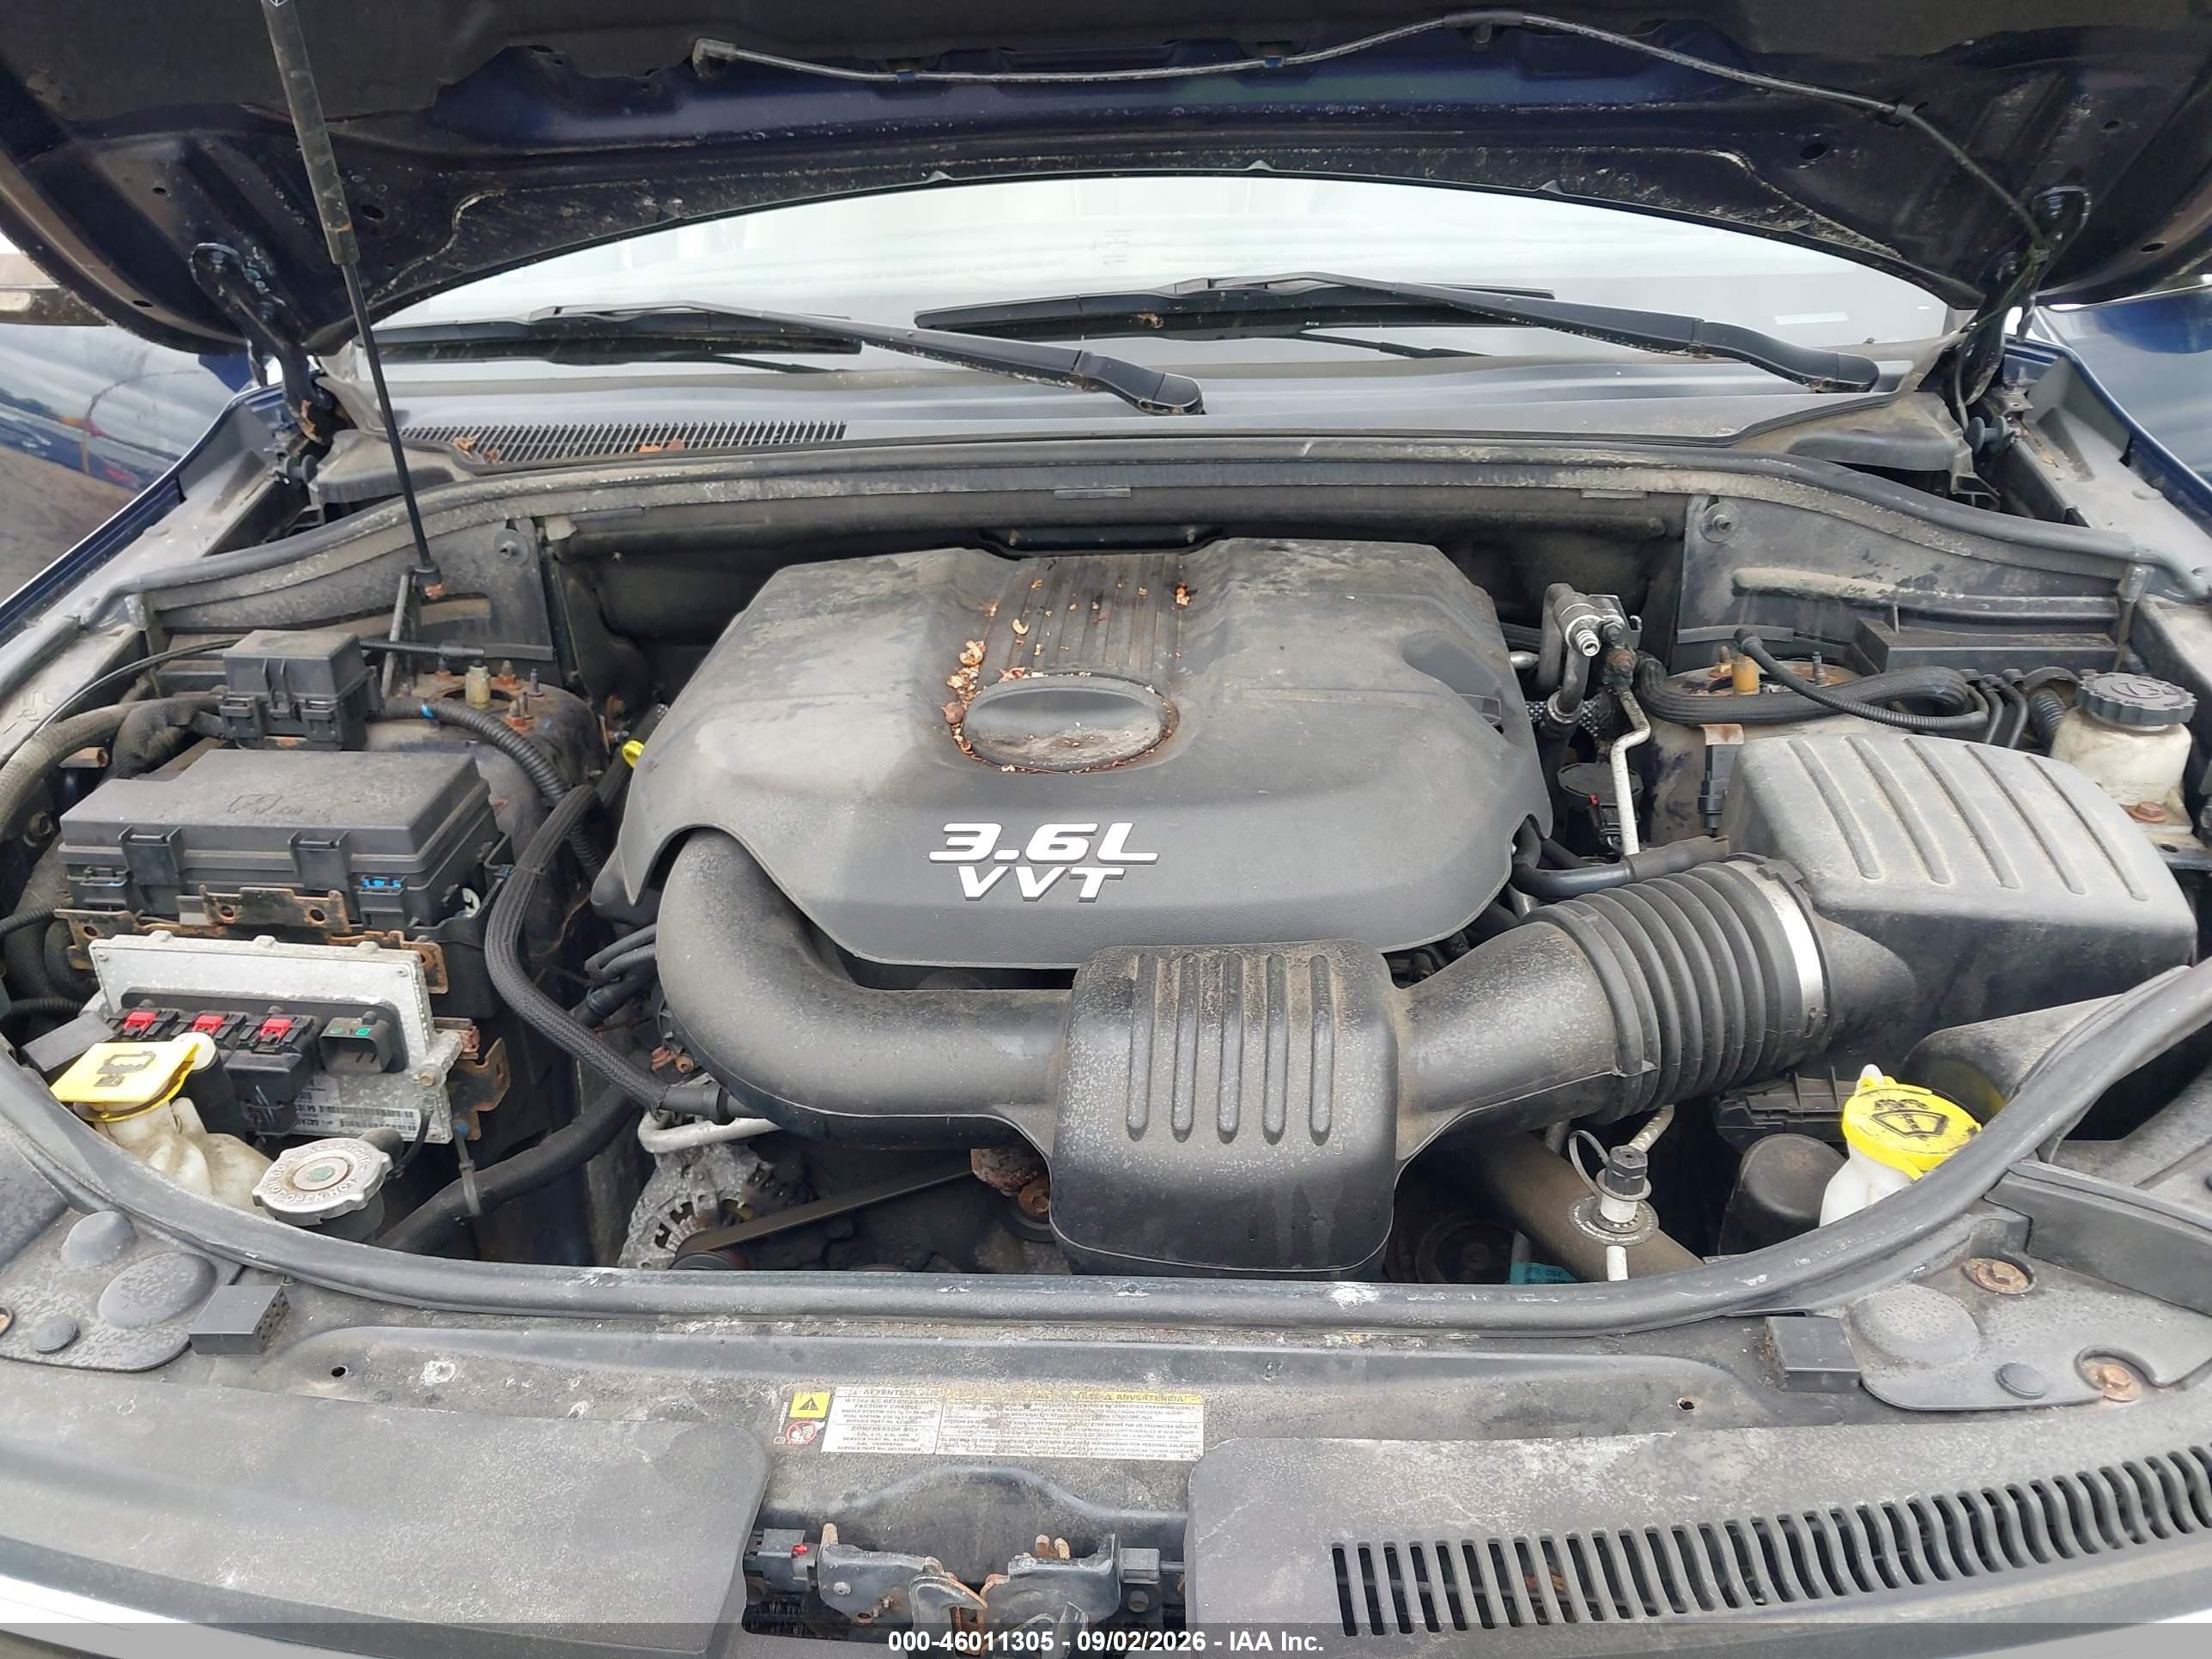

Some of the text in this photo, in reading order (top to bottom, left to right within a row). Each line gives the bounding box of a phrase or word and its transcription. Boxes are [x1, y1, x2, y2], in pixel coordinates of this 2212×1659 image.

[929, 823, 1159, 864] 3.6L
[957, 866, 1126, 902] VVT
[286, 1191, 325, 1203] OPEN
[327, 1176, 358, 1197] HOT
